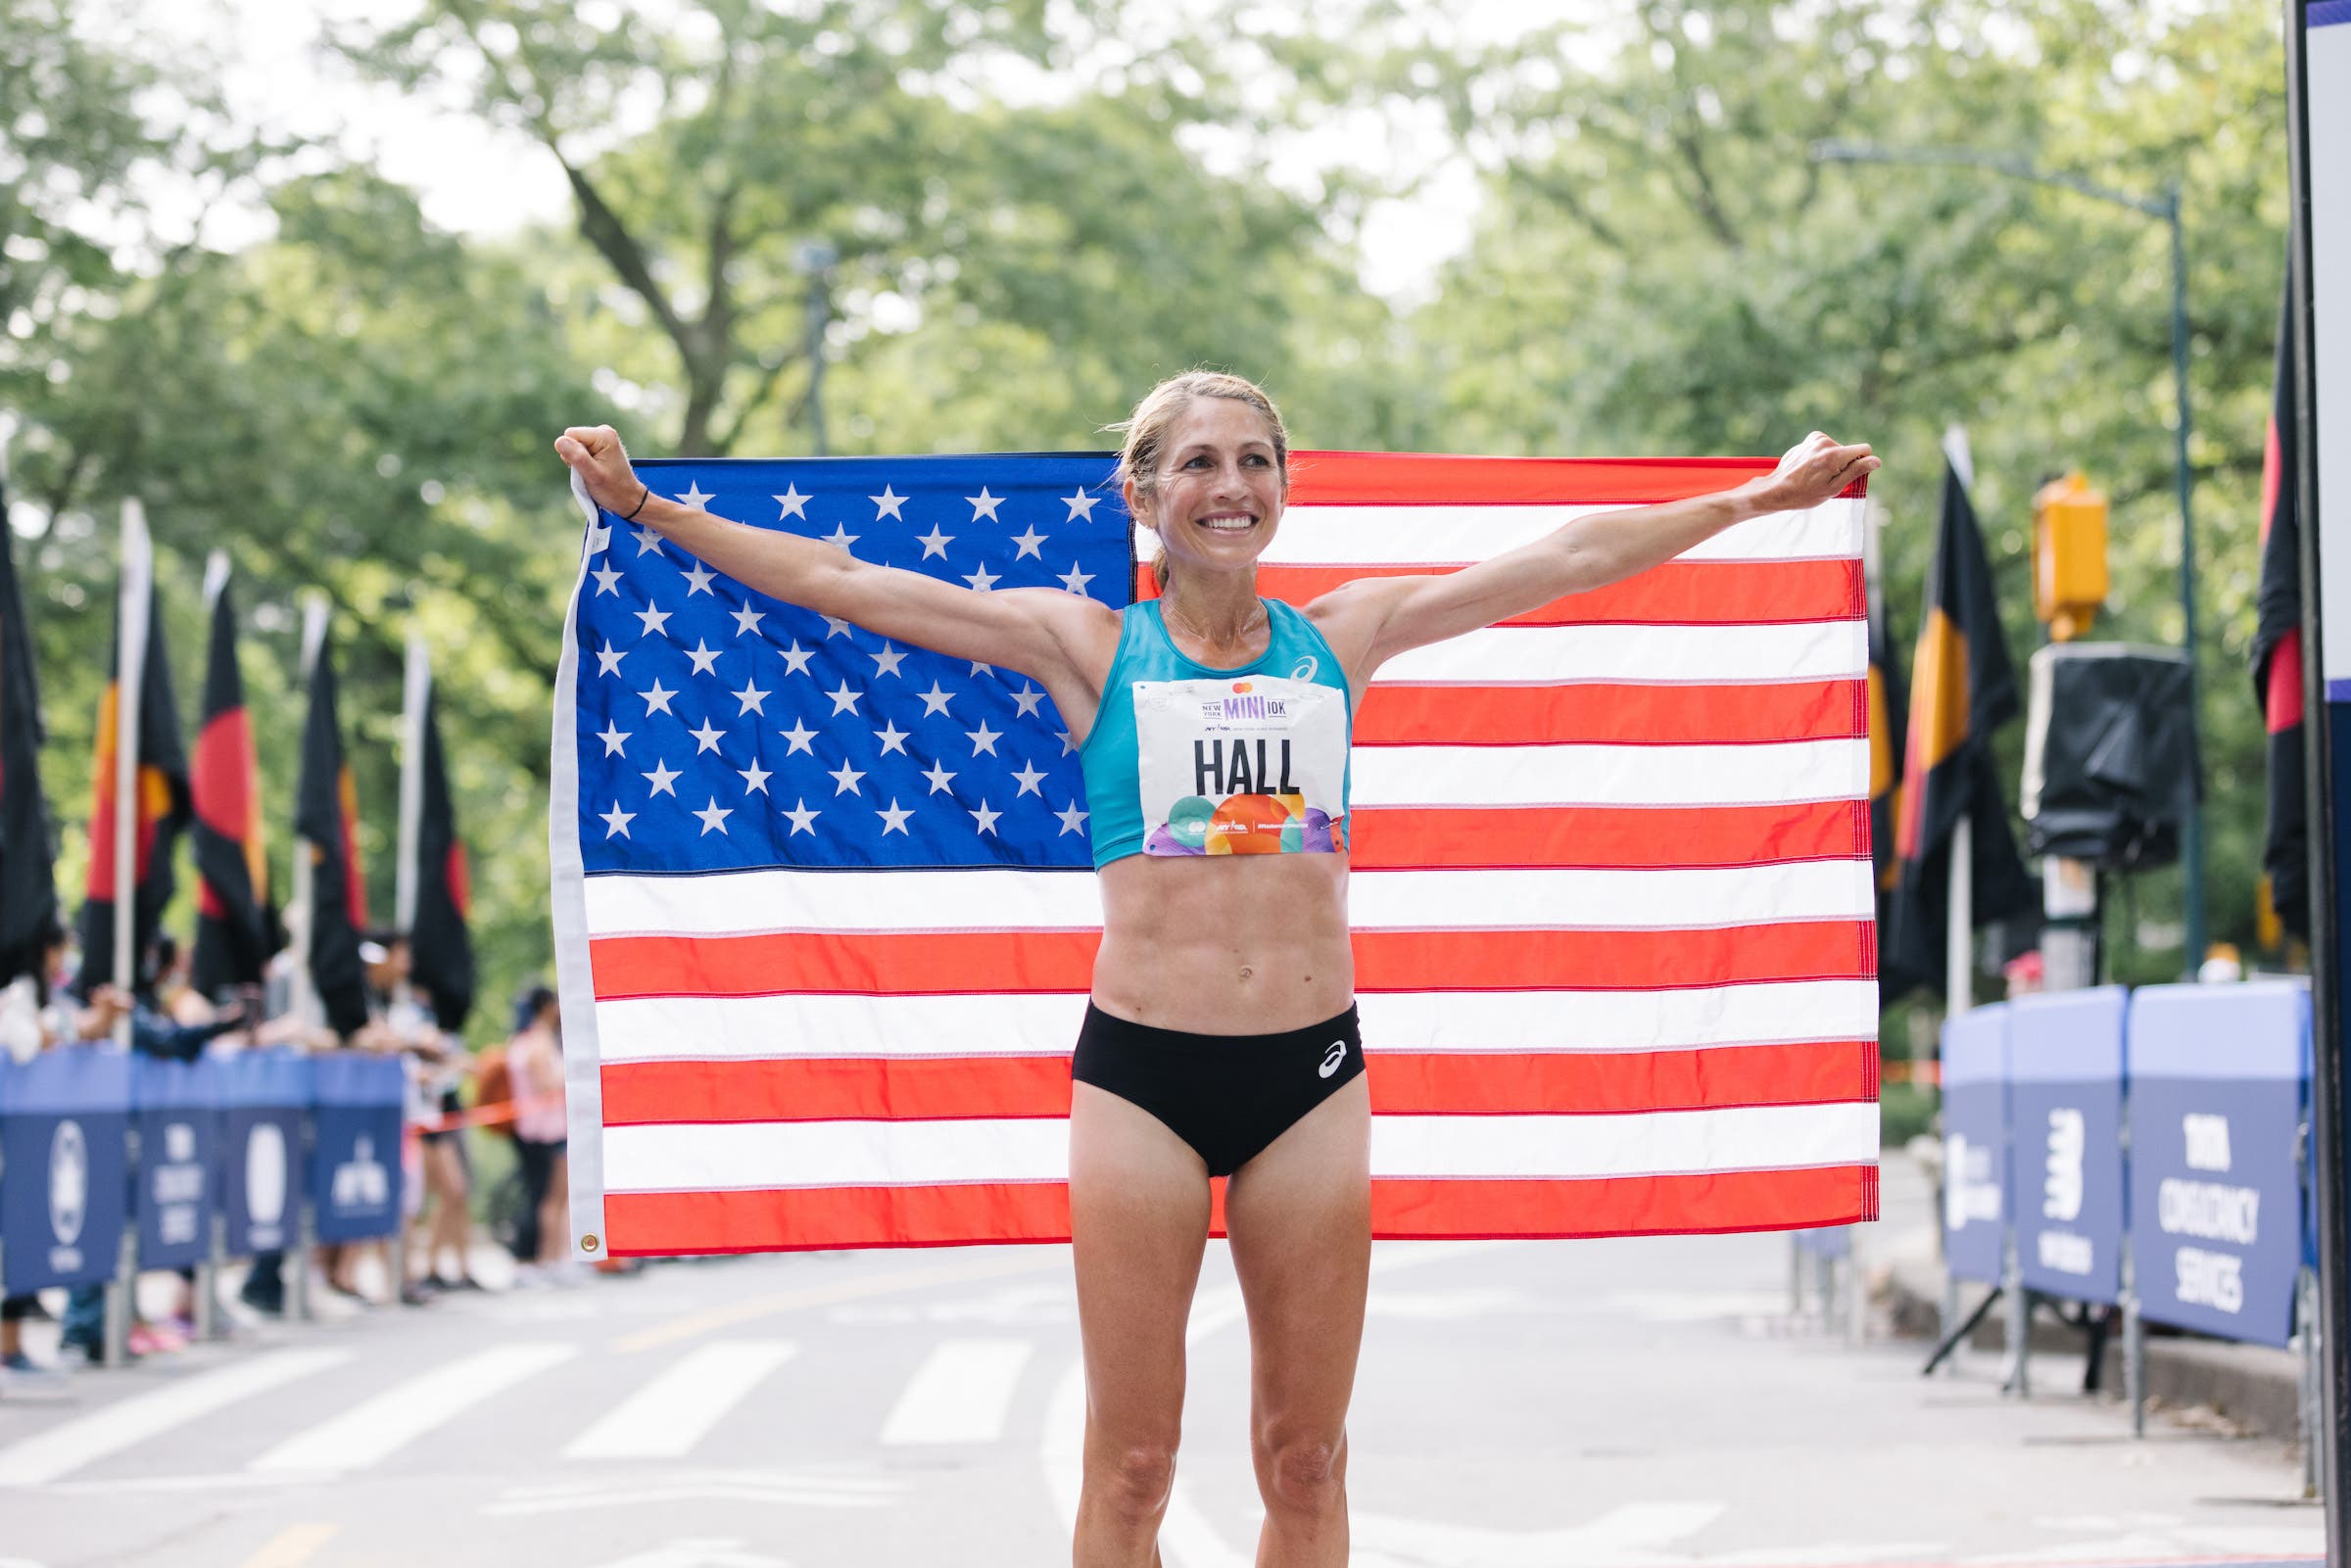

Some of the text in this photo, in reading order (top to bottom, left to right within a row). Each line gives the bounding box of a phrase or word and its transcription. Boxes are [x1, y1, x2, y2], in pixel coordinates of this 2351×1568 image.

[1223, 695, 1286, 720] MINI 10K
[1194, 738, 1300, 796] HALL
